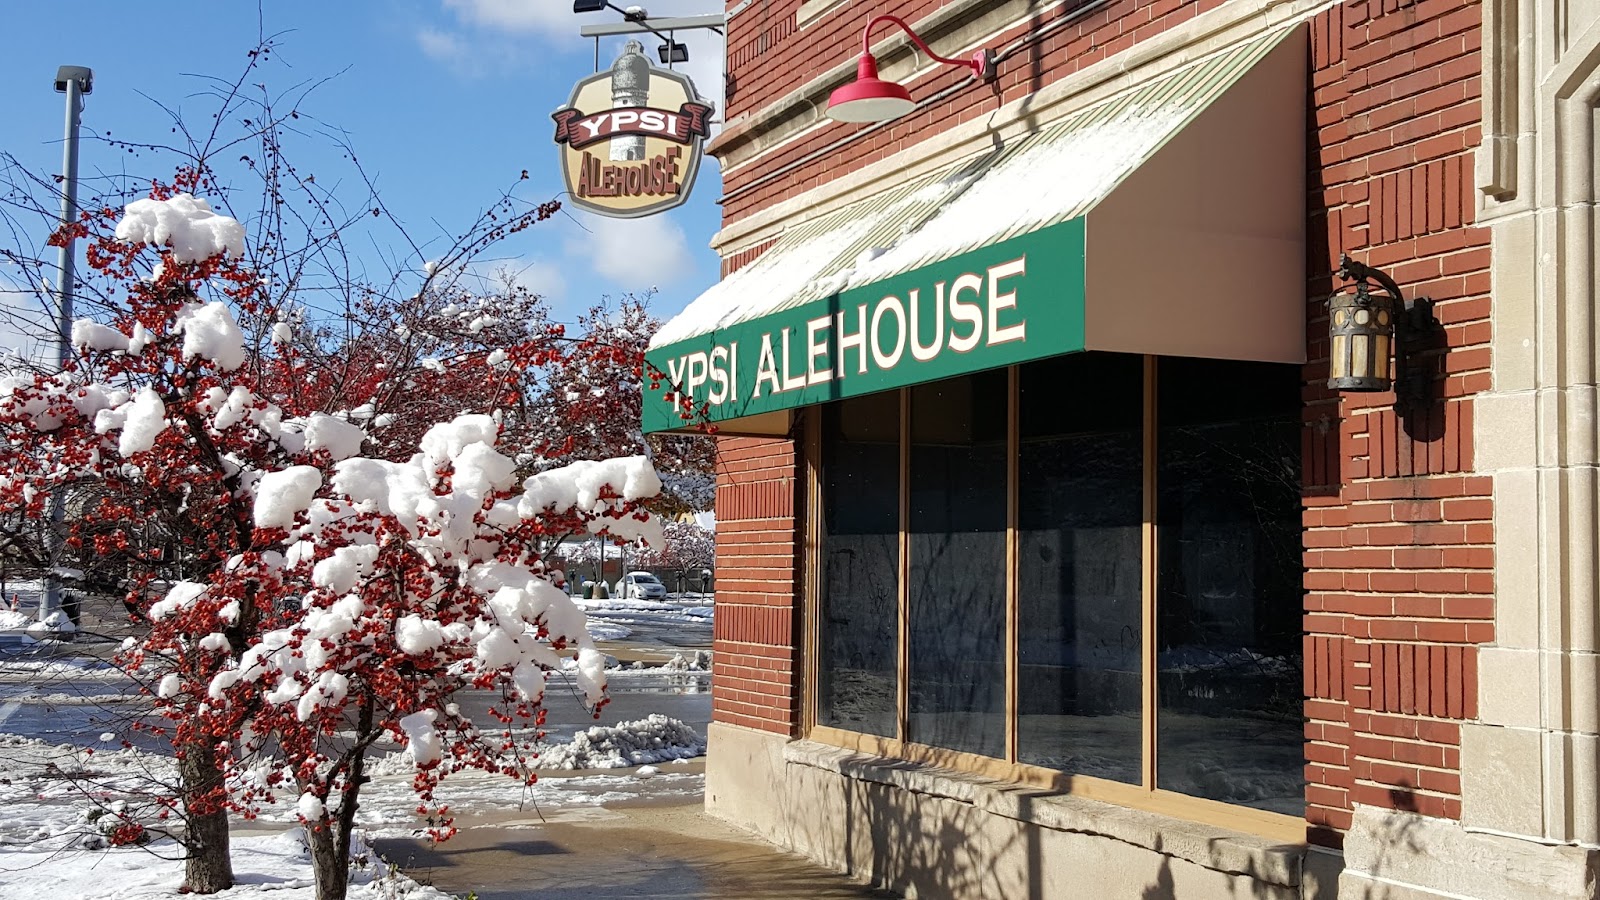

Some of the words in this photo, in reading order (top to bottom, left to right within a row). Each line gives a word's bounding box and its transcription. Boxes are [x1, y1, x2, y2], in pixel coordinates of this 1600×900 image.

[579, 110, 678, 138] YPSI
[577, 146, 681, 197] ALEHOUSE
[667, 341, 738, 413] YPSI
[753, 252, 1026, 398] ALEHOUSE
